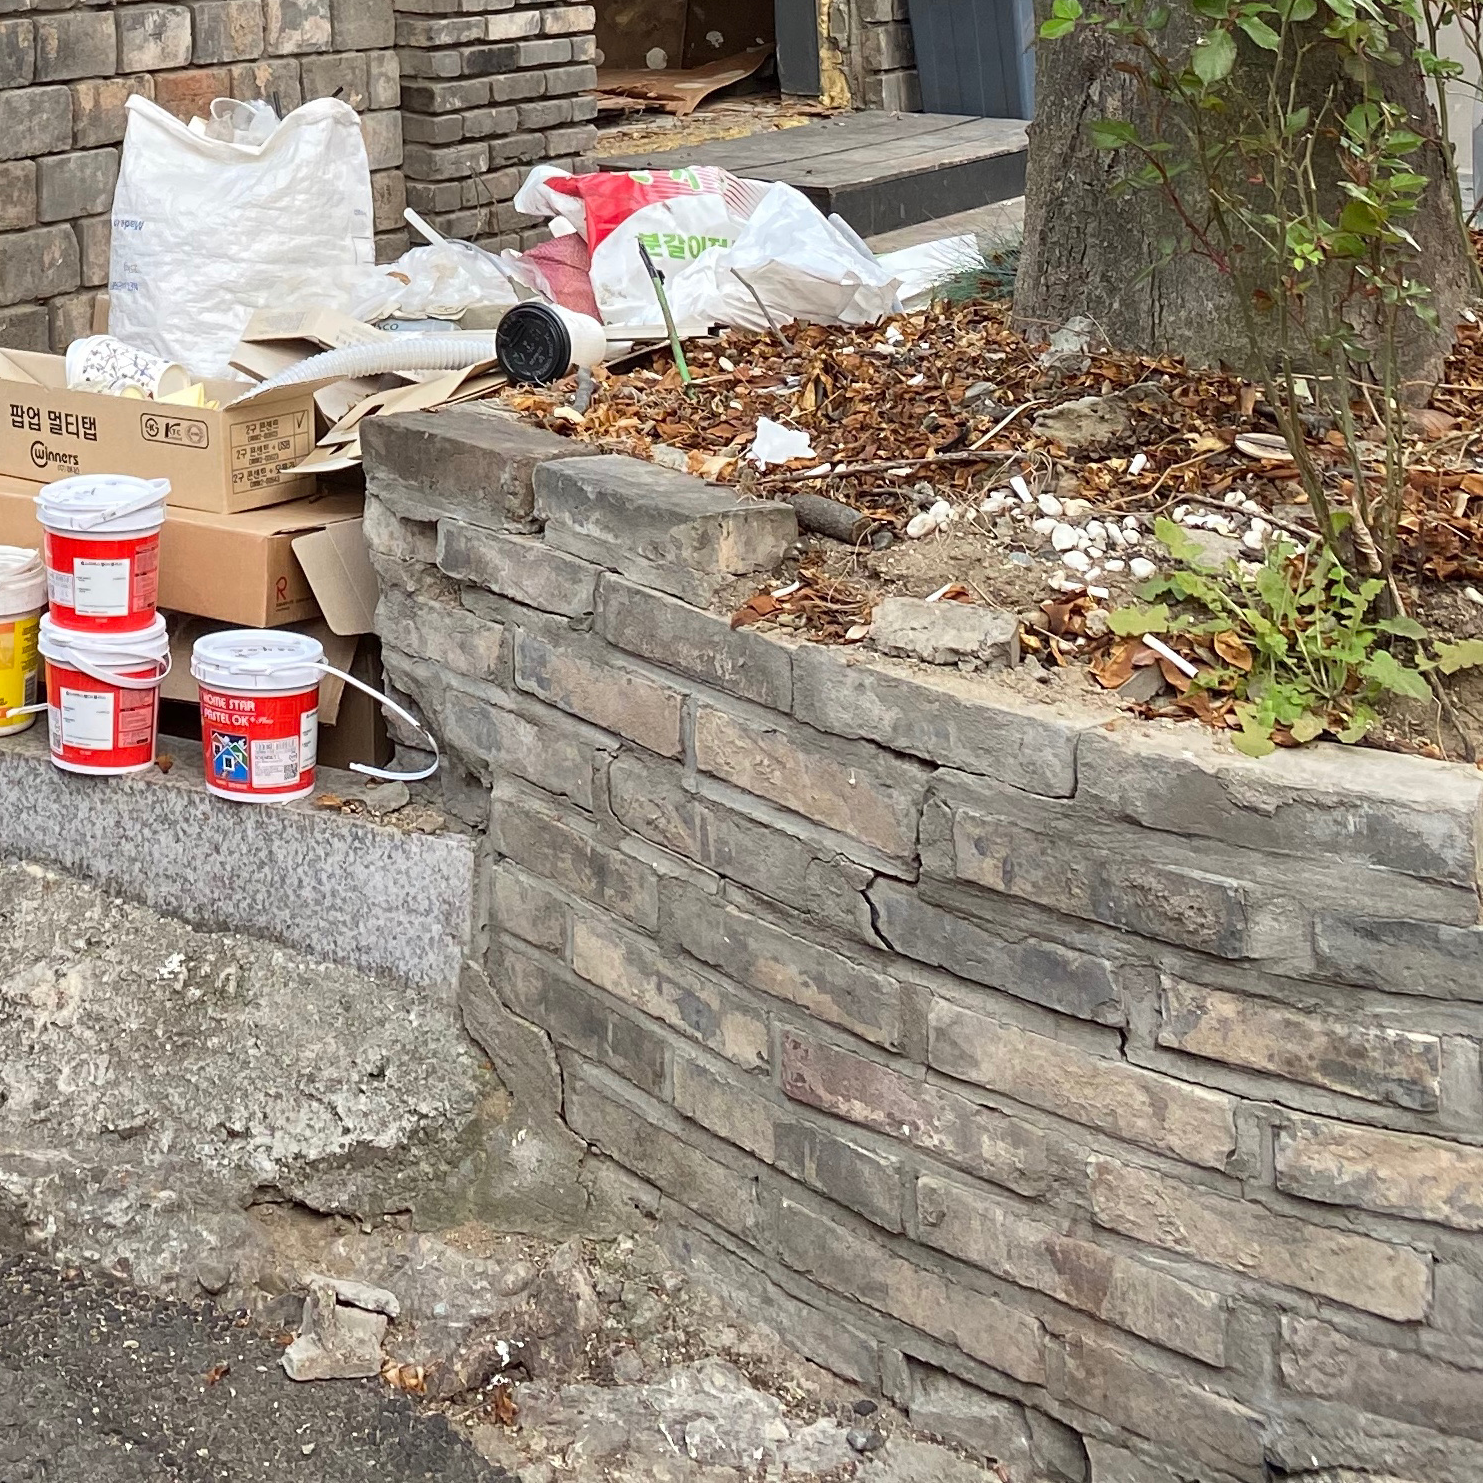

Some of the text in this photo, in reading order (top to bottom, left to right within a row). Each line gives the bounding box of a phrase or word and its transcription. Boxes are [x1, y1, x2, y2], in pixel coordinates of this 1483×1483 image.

[637, 233, 735, 260] 분갈이
[9, 403, 98, 442] 팝업 멀티탭
[276, 576, 287, 602] R
[229, 698, 255, 712] STAR
